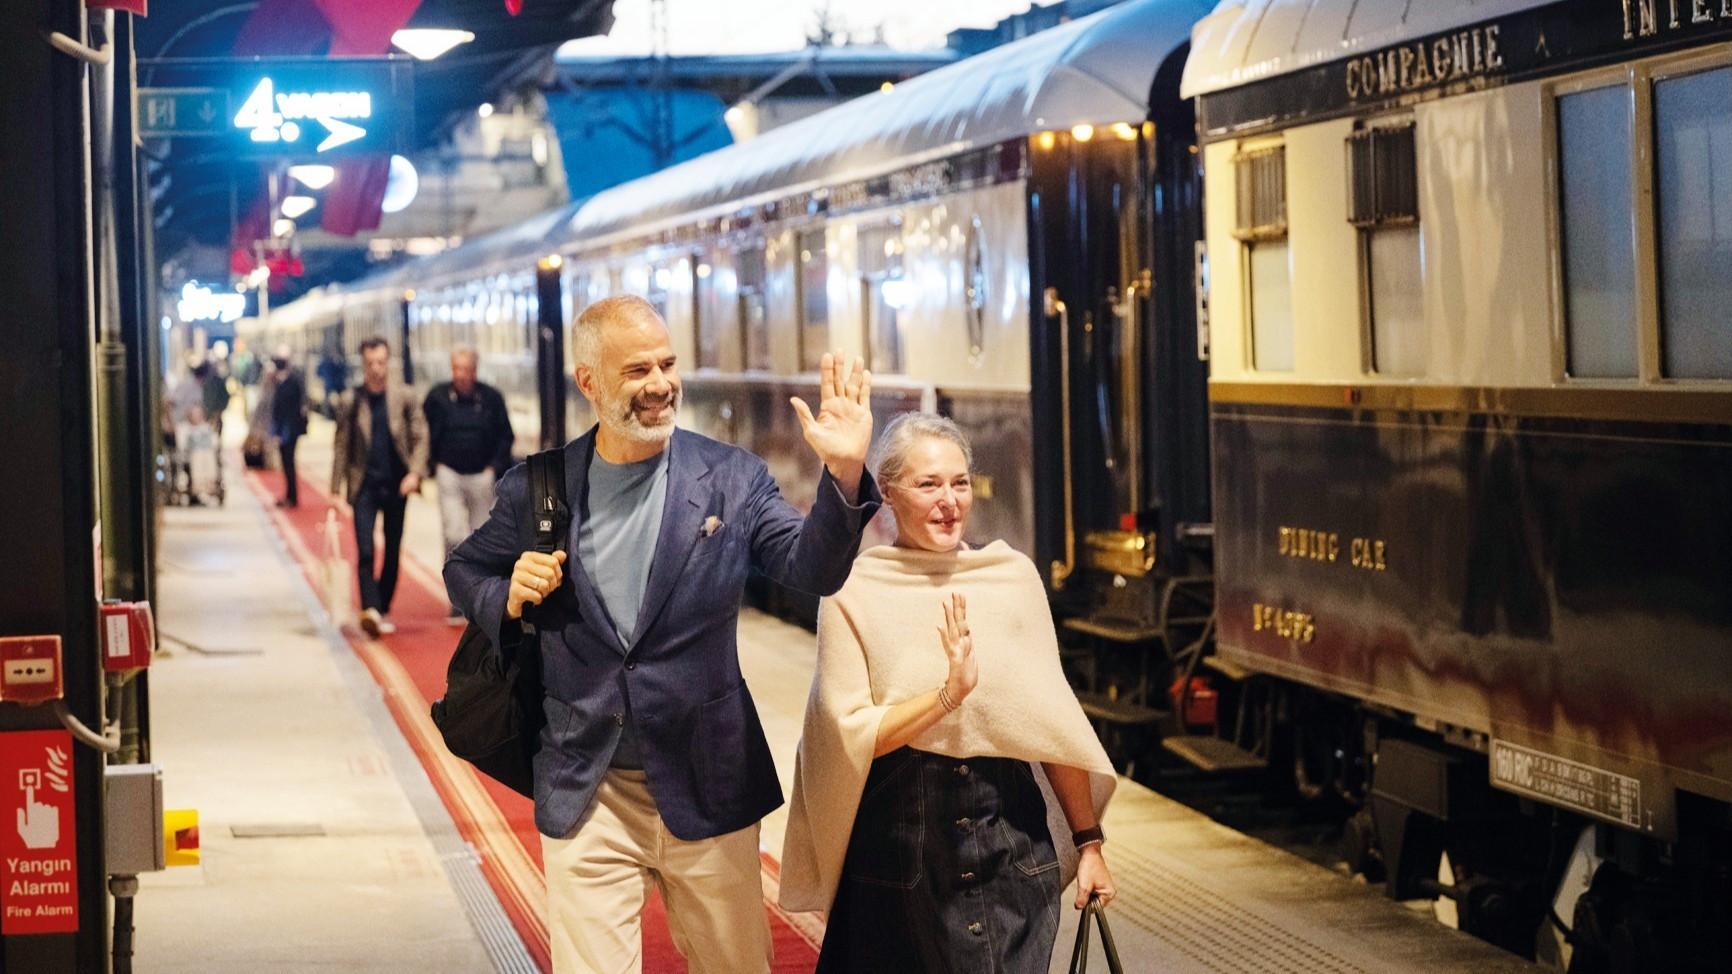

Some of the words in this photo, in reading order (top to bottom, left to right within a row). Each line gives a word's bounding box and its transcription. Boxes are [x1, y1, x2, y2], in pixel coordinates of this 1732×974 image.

[1346, 25, 1503, 98] COMPAGNIE
[1279, 526, 1338, 562] DINING
[1351, 537, 1386, 570] CAR
[7, 857, 71, 876] Yangın
[10, 879, 70, 896] Alarmı
[7, 906, 32, 918] Fire
[35, 904, 73, 917] Alarm
